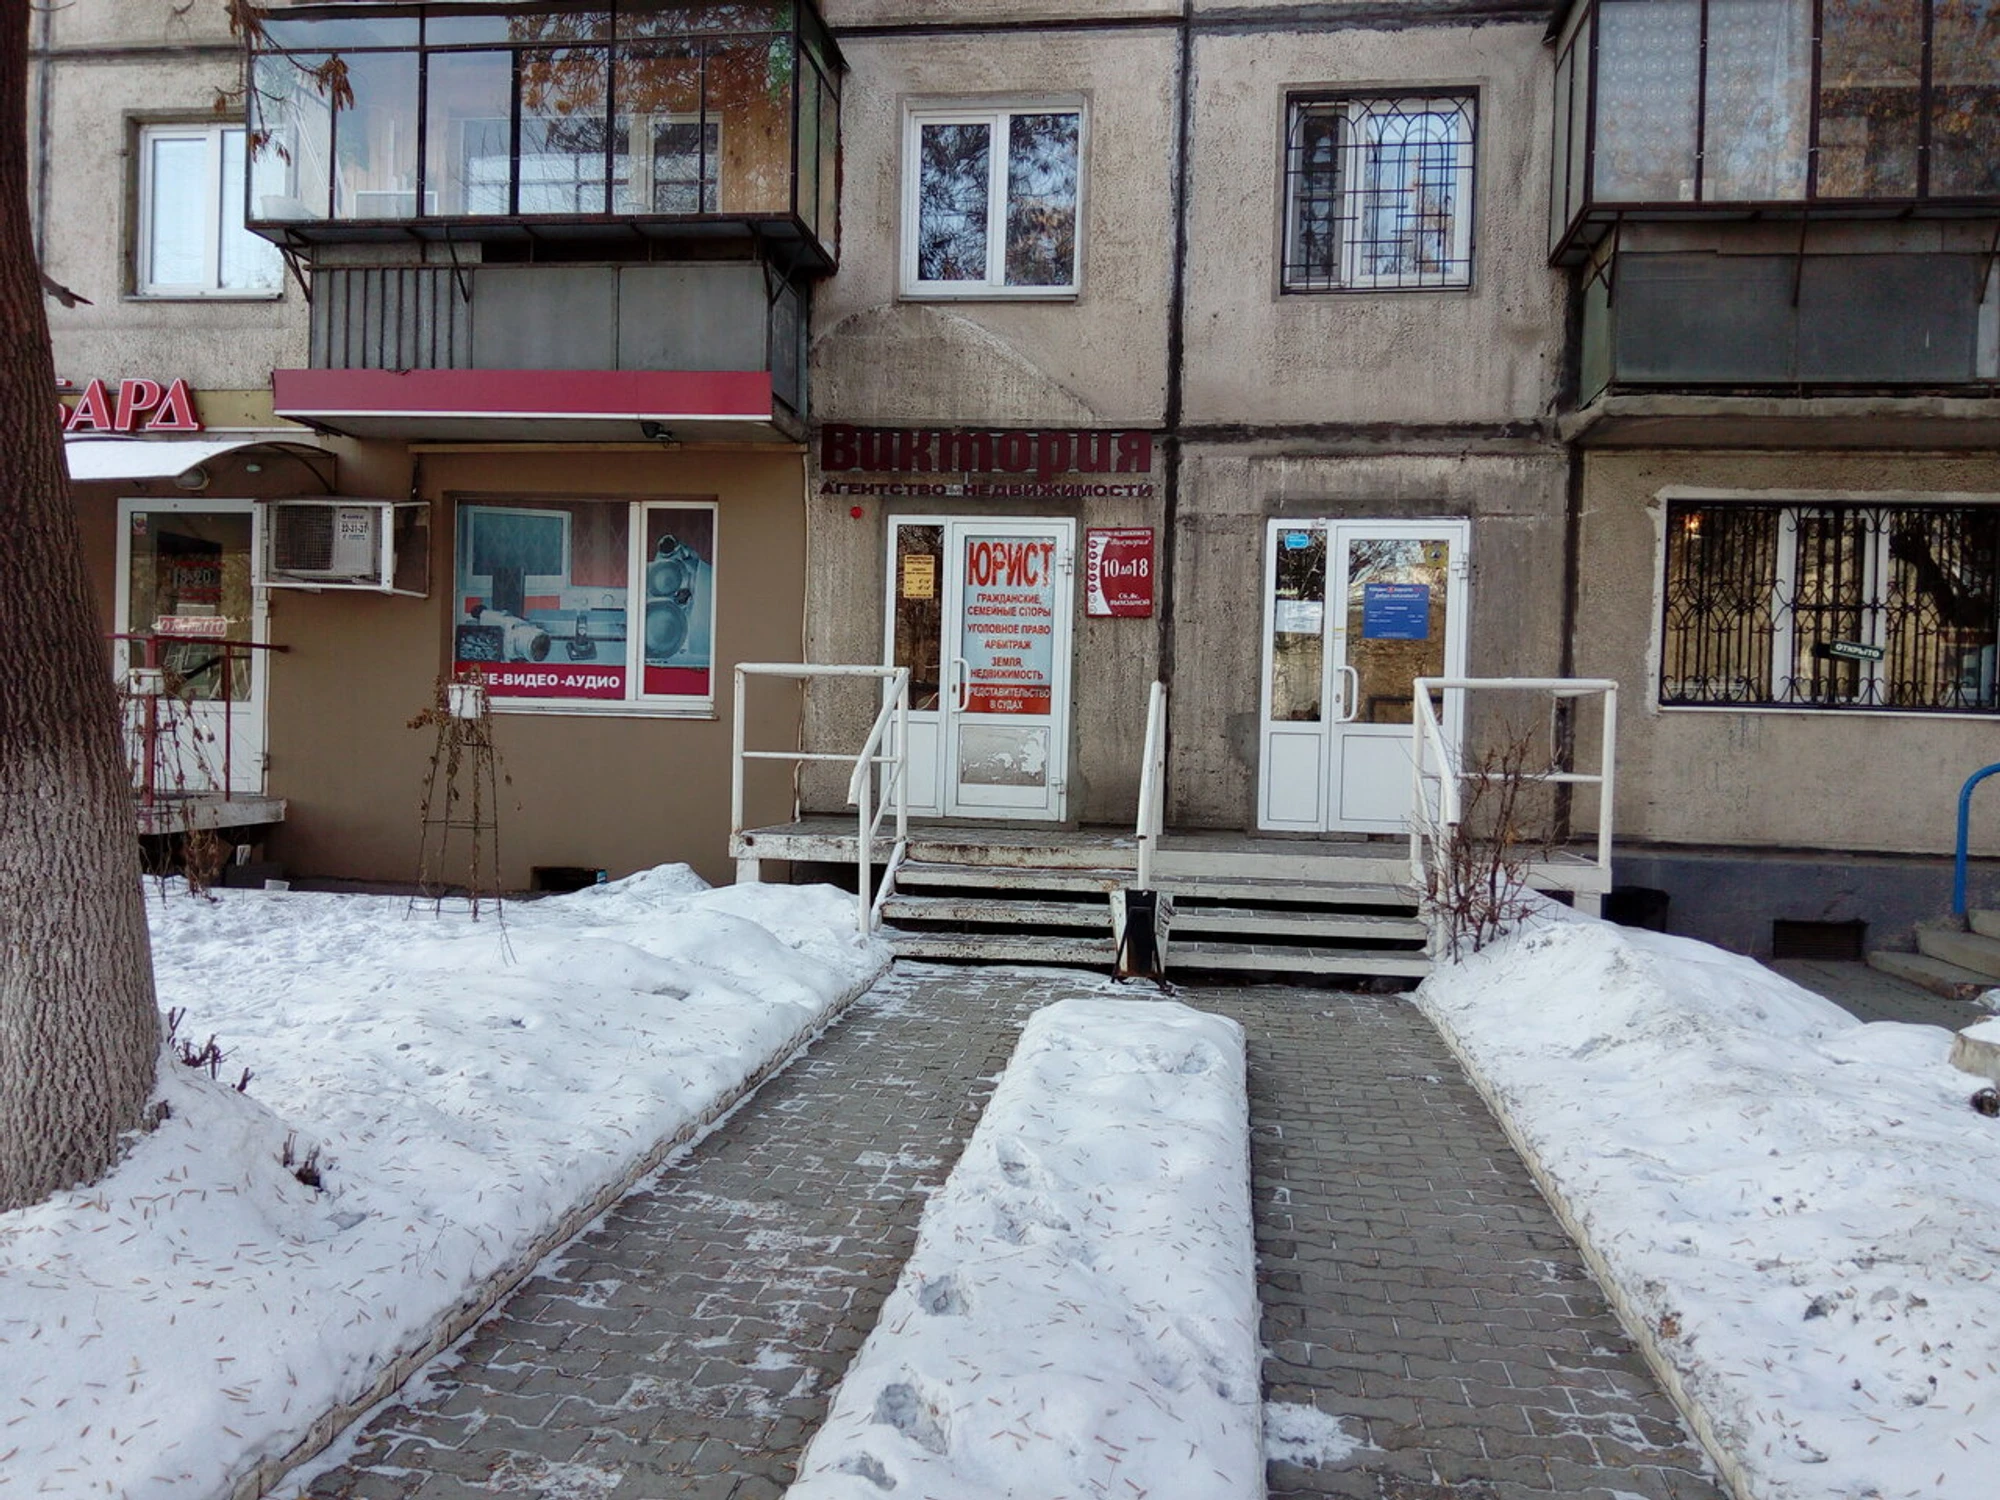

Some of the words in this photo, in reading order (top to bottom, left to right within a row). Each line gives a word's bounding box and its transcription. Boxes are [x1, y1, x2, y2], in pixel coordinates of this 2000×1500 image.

[56, 377, 204, 431] АРД
[820, 424, 1151, 484] Виктория
[820, 482, 946, 496] АГЕНТСТВО
[963, 483, 1153, 498] НЕДВИЖИМОСТИ
[967, 541, 1055, 587] ЮРИСТ
[1101, 558, 1119, 578] 10
[1131, 557, 1149, 577] 18
[967, 606, 1017, 617] СЕМЕЙНЫЕ
[1018, 607, 1051, 618] СПОРЫ
[967, 623, 1019, 634] УГОЛОВНОЕ
[1020, 624, 1051, 635] ПРАВО
[984, 639, 1032, 650] АРБИТРАЖ
[1835, 643, 1880, 658] ОТКРЫТО
[970, 668, 1044, 680] НЕДВИЖИМОСТЬ
[966, 686, 1051, 699] РЕДСТАВИТЕЛЬСТВО
[989, 699, 996, 709] В
[997, 700, 1023, 711] СУДАХ
